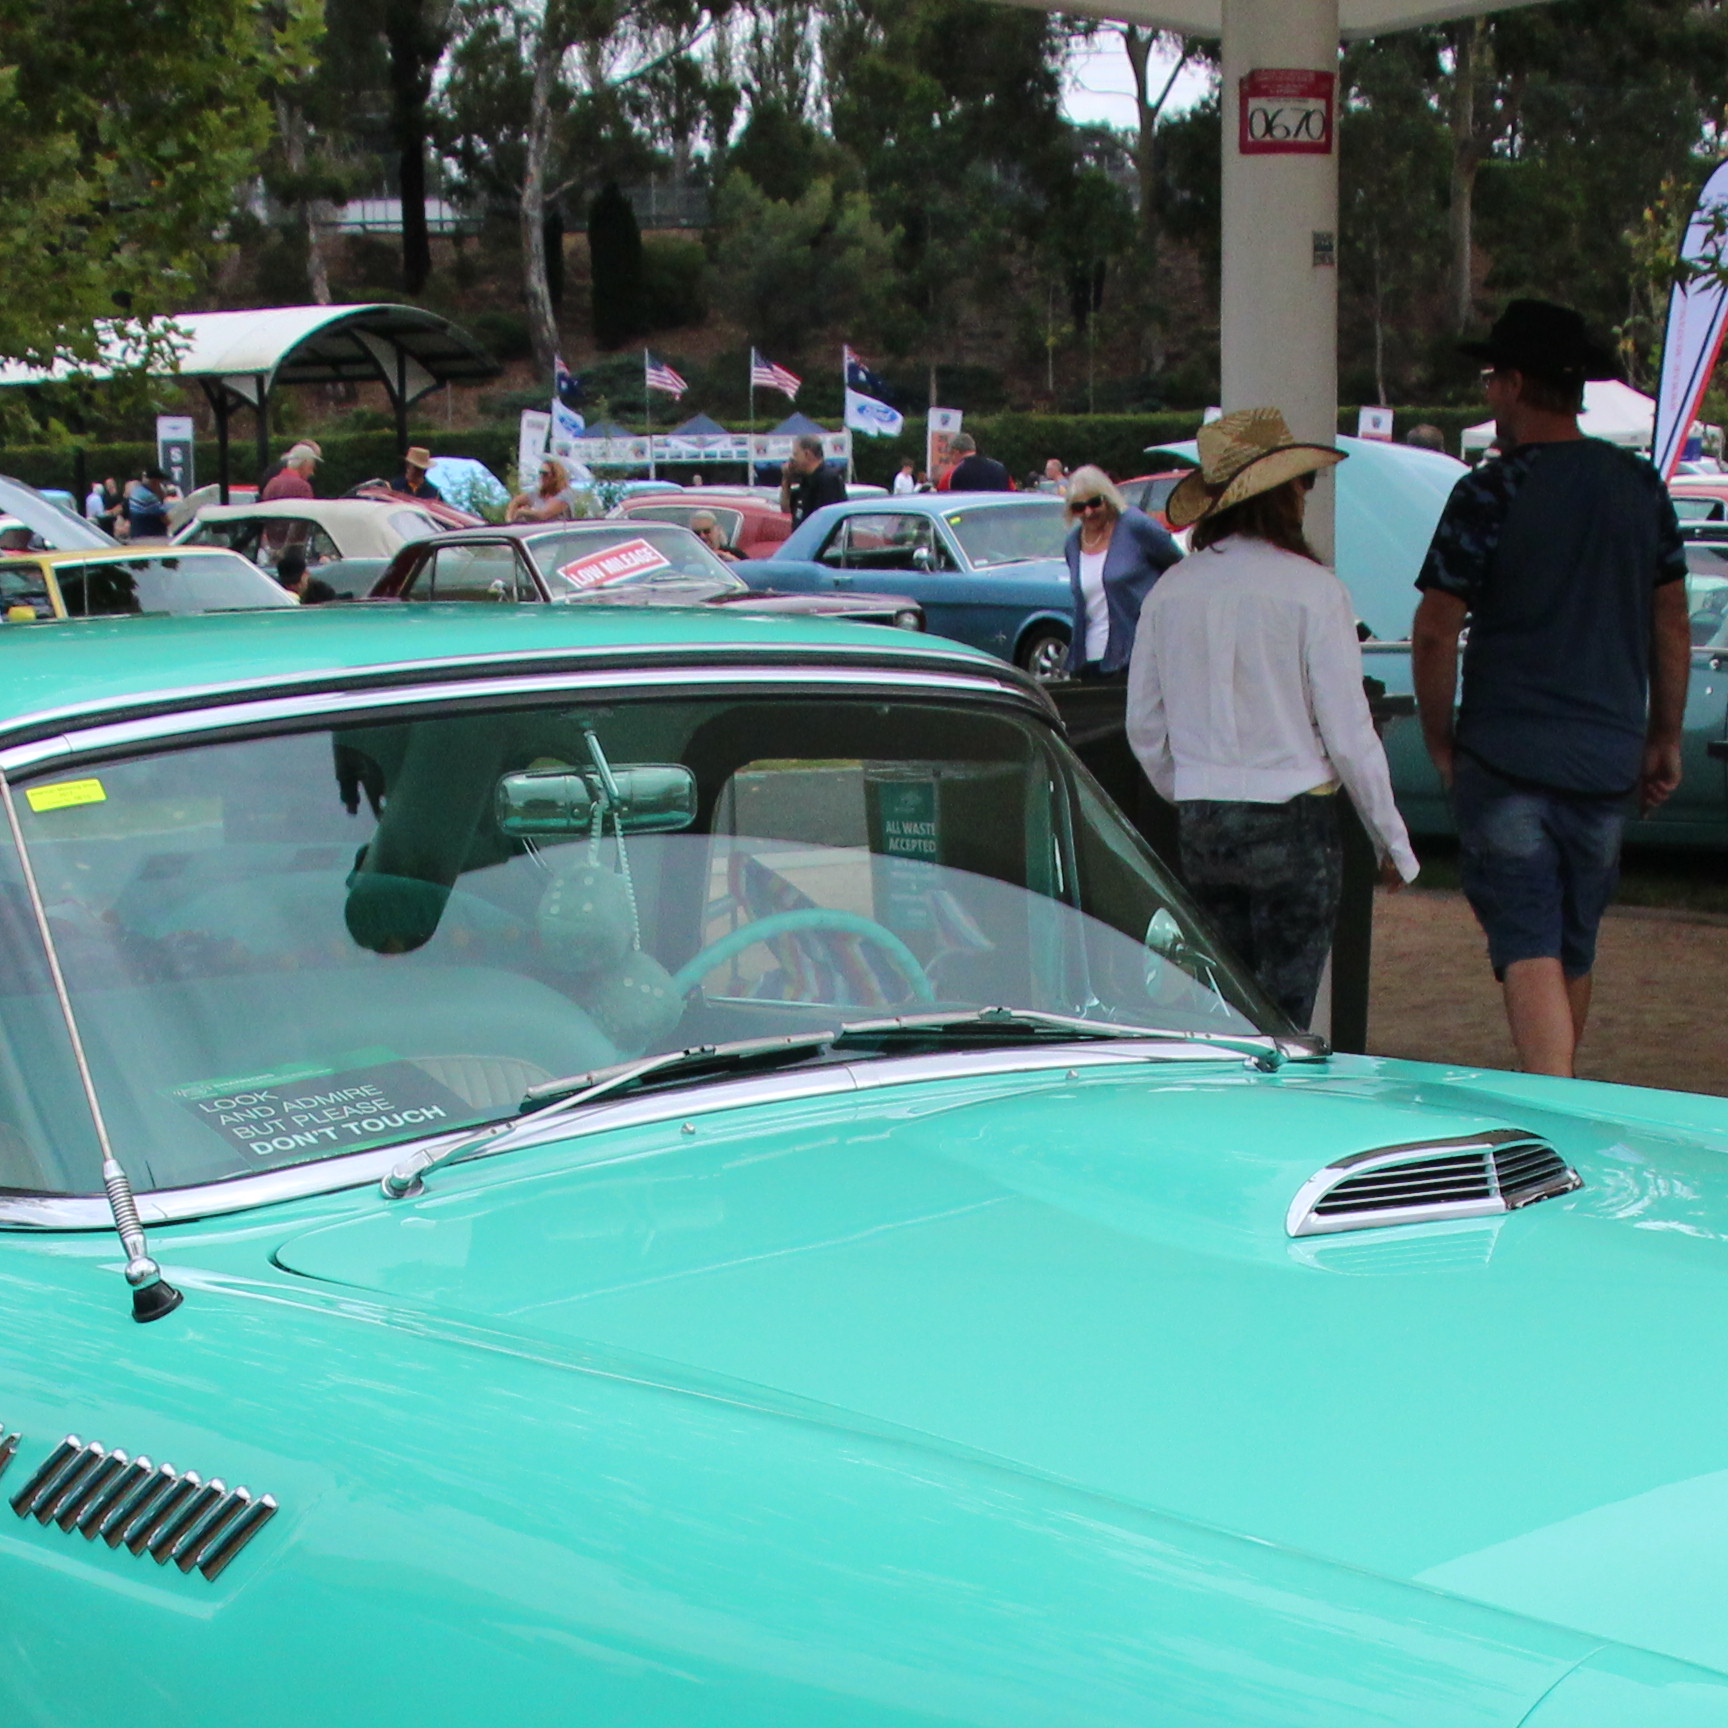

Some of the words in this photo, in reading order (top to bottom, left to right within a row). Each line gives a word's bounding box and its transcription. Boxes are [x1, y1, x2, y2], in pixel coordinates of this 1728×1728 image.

[1249, 107, 1326, 140] 0670
[571, 565, 605, 586] LOW
[600, 547, 659, 575] MILEAGE
[886, 821, 901, 835] ALL
[889, 837, 936, 853] ACCEPTED
[198, 1090, 279, 1113] LOOK
[219, 1106, 277, 1126] AND
[281, 1084, 383, 1114] ADMIRE
[232, 1118, 288, 1141] BUT
[291, 1098, 396, 1128] PLEASE
[249, 1126, 339, 1157] DON'T
[341, 1105, 447, 1136] TOUCH
